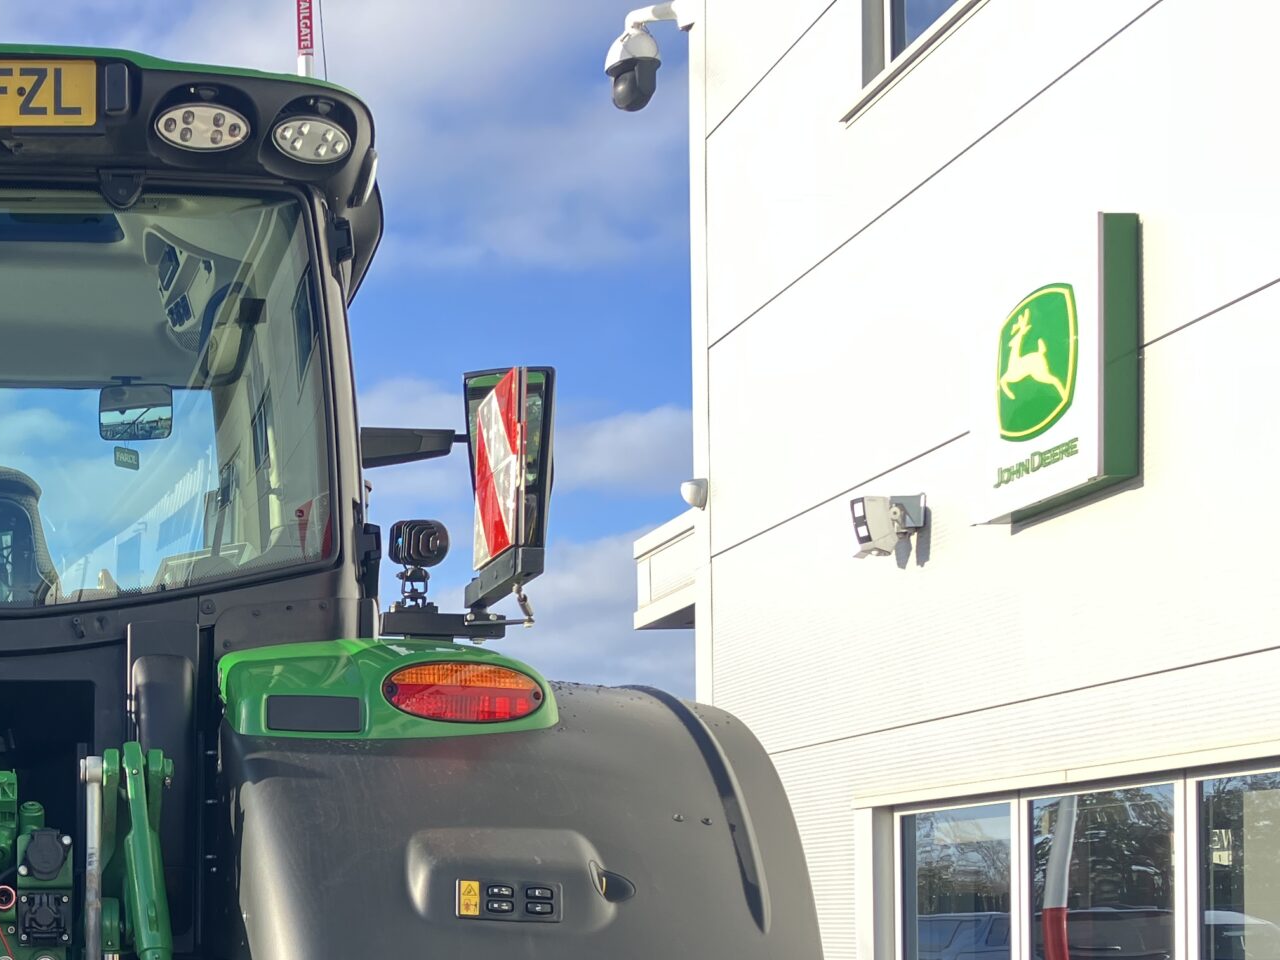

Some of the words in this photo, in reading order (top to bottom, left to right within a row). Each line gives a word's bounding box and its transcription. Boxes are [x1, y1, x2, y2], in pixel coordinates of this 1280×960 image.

[299, 0, 311, 49] AILGATE
[993, 458, 1030, 488] JOHN
[1030, 437, 1079, 472] DEERE
